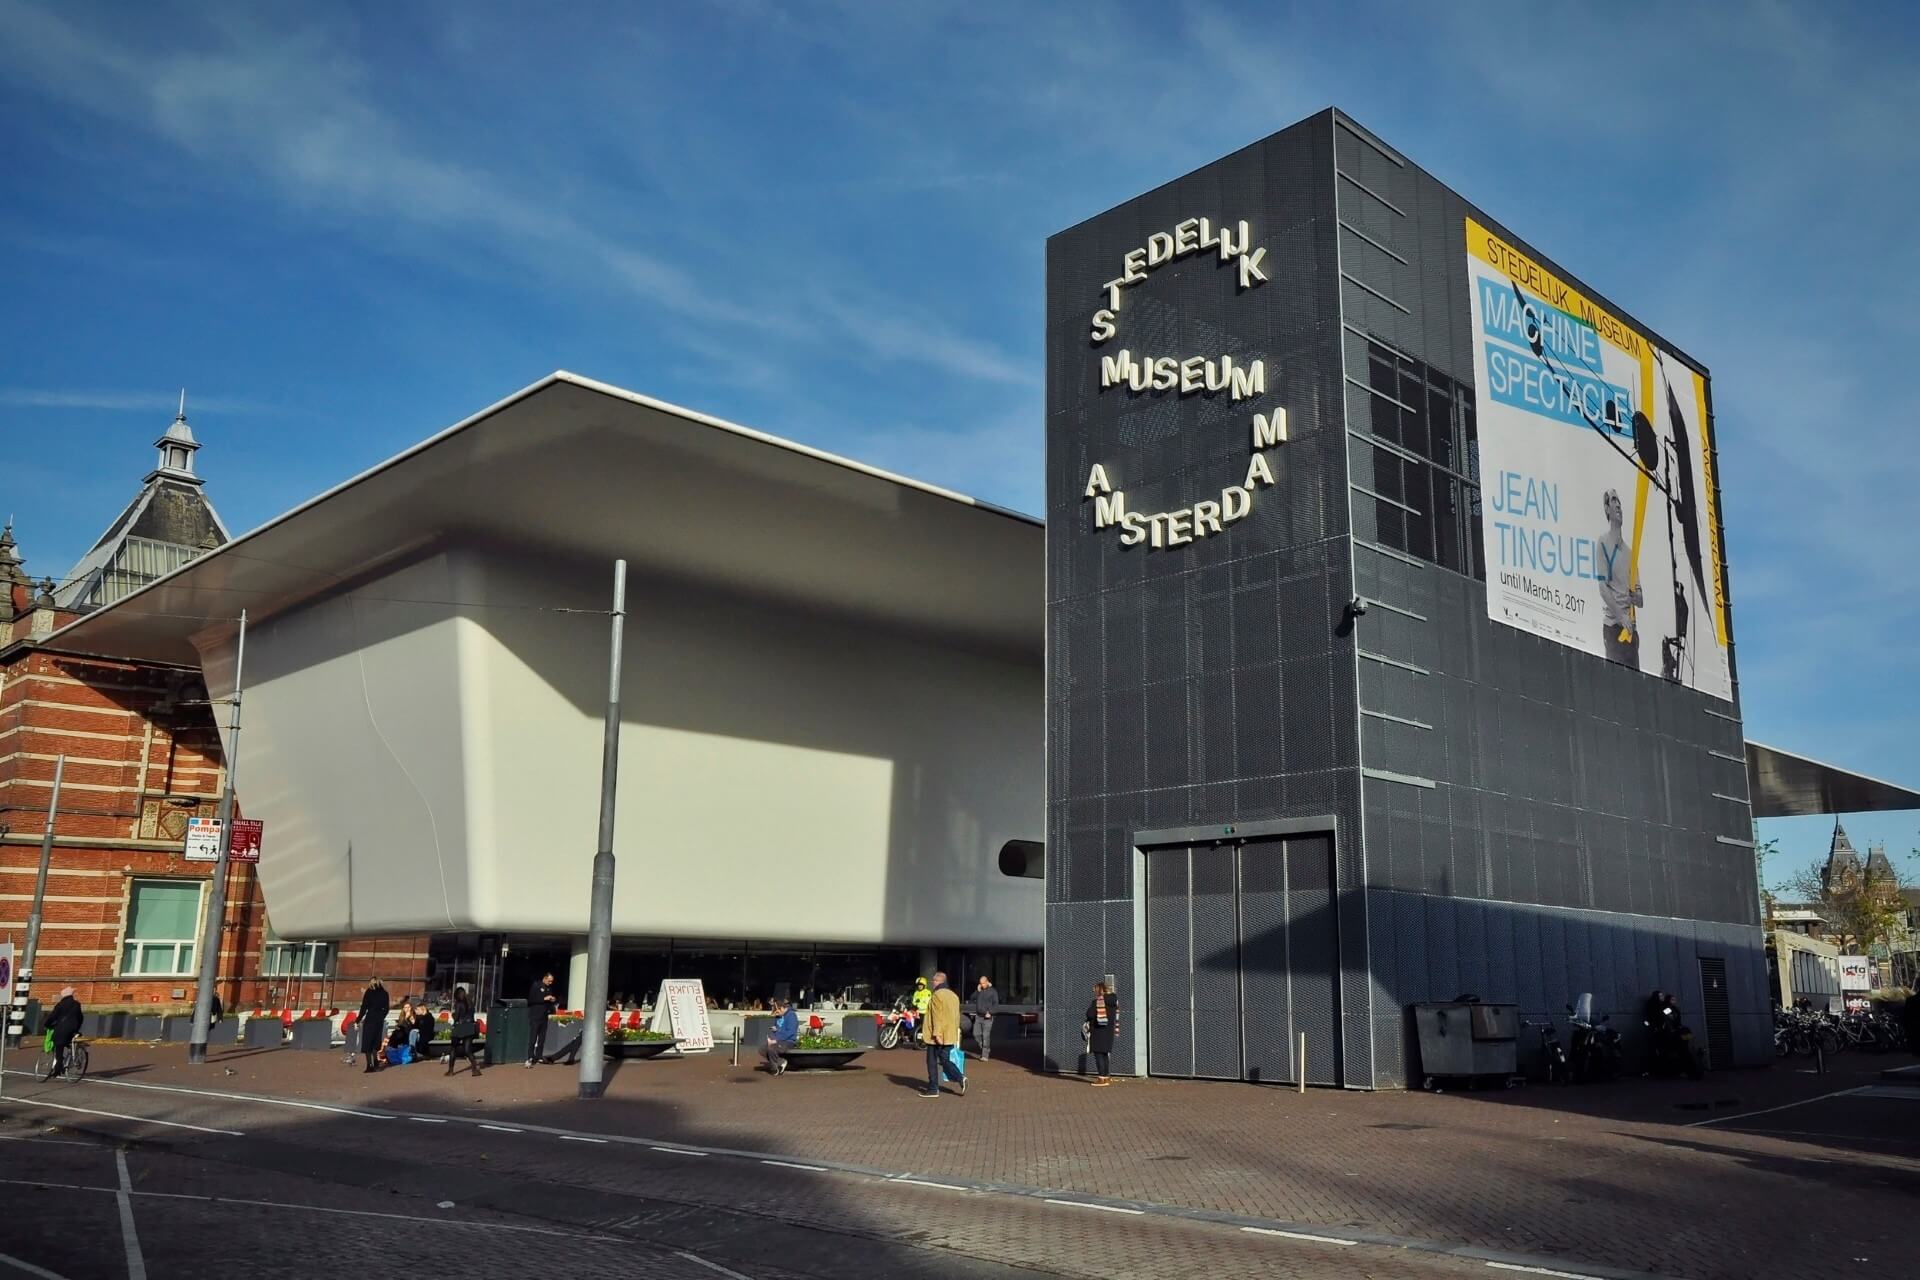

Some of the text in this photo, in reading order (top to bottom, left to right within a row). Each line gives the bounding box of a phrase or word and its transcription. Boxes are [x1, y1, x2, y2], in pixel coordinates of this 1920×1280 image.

[1091, 216, 1268, 342] STEDELIJK
[1487, 237, 1642, 357] STEDELIJK MUSEUM
[1484, 286, 1597, 364] MACHINE
[1101, 349, 1265, 400] MUSEUM
[1490, 351, 1631, 429] SPECTACLE
[1085, 406, 1288, 549] AMSTERDAM
[1492, 470, 1559, 524] JEAN
[1494, 521, 1619, 582] TINGUELY
[1701, 433, 1722, 609] AMSTERDAM
[1500, 571, 1522, 590] until
[1522, 576, 1553, 603] March
[1555, 589, 1564, 609] 5,
[1565, 593, 1586, 616] 2017
[189, 825, 220, 835] Pompa
